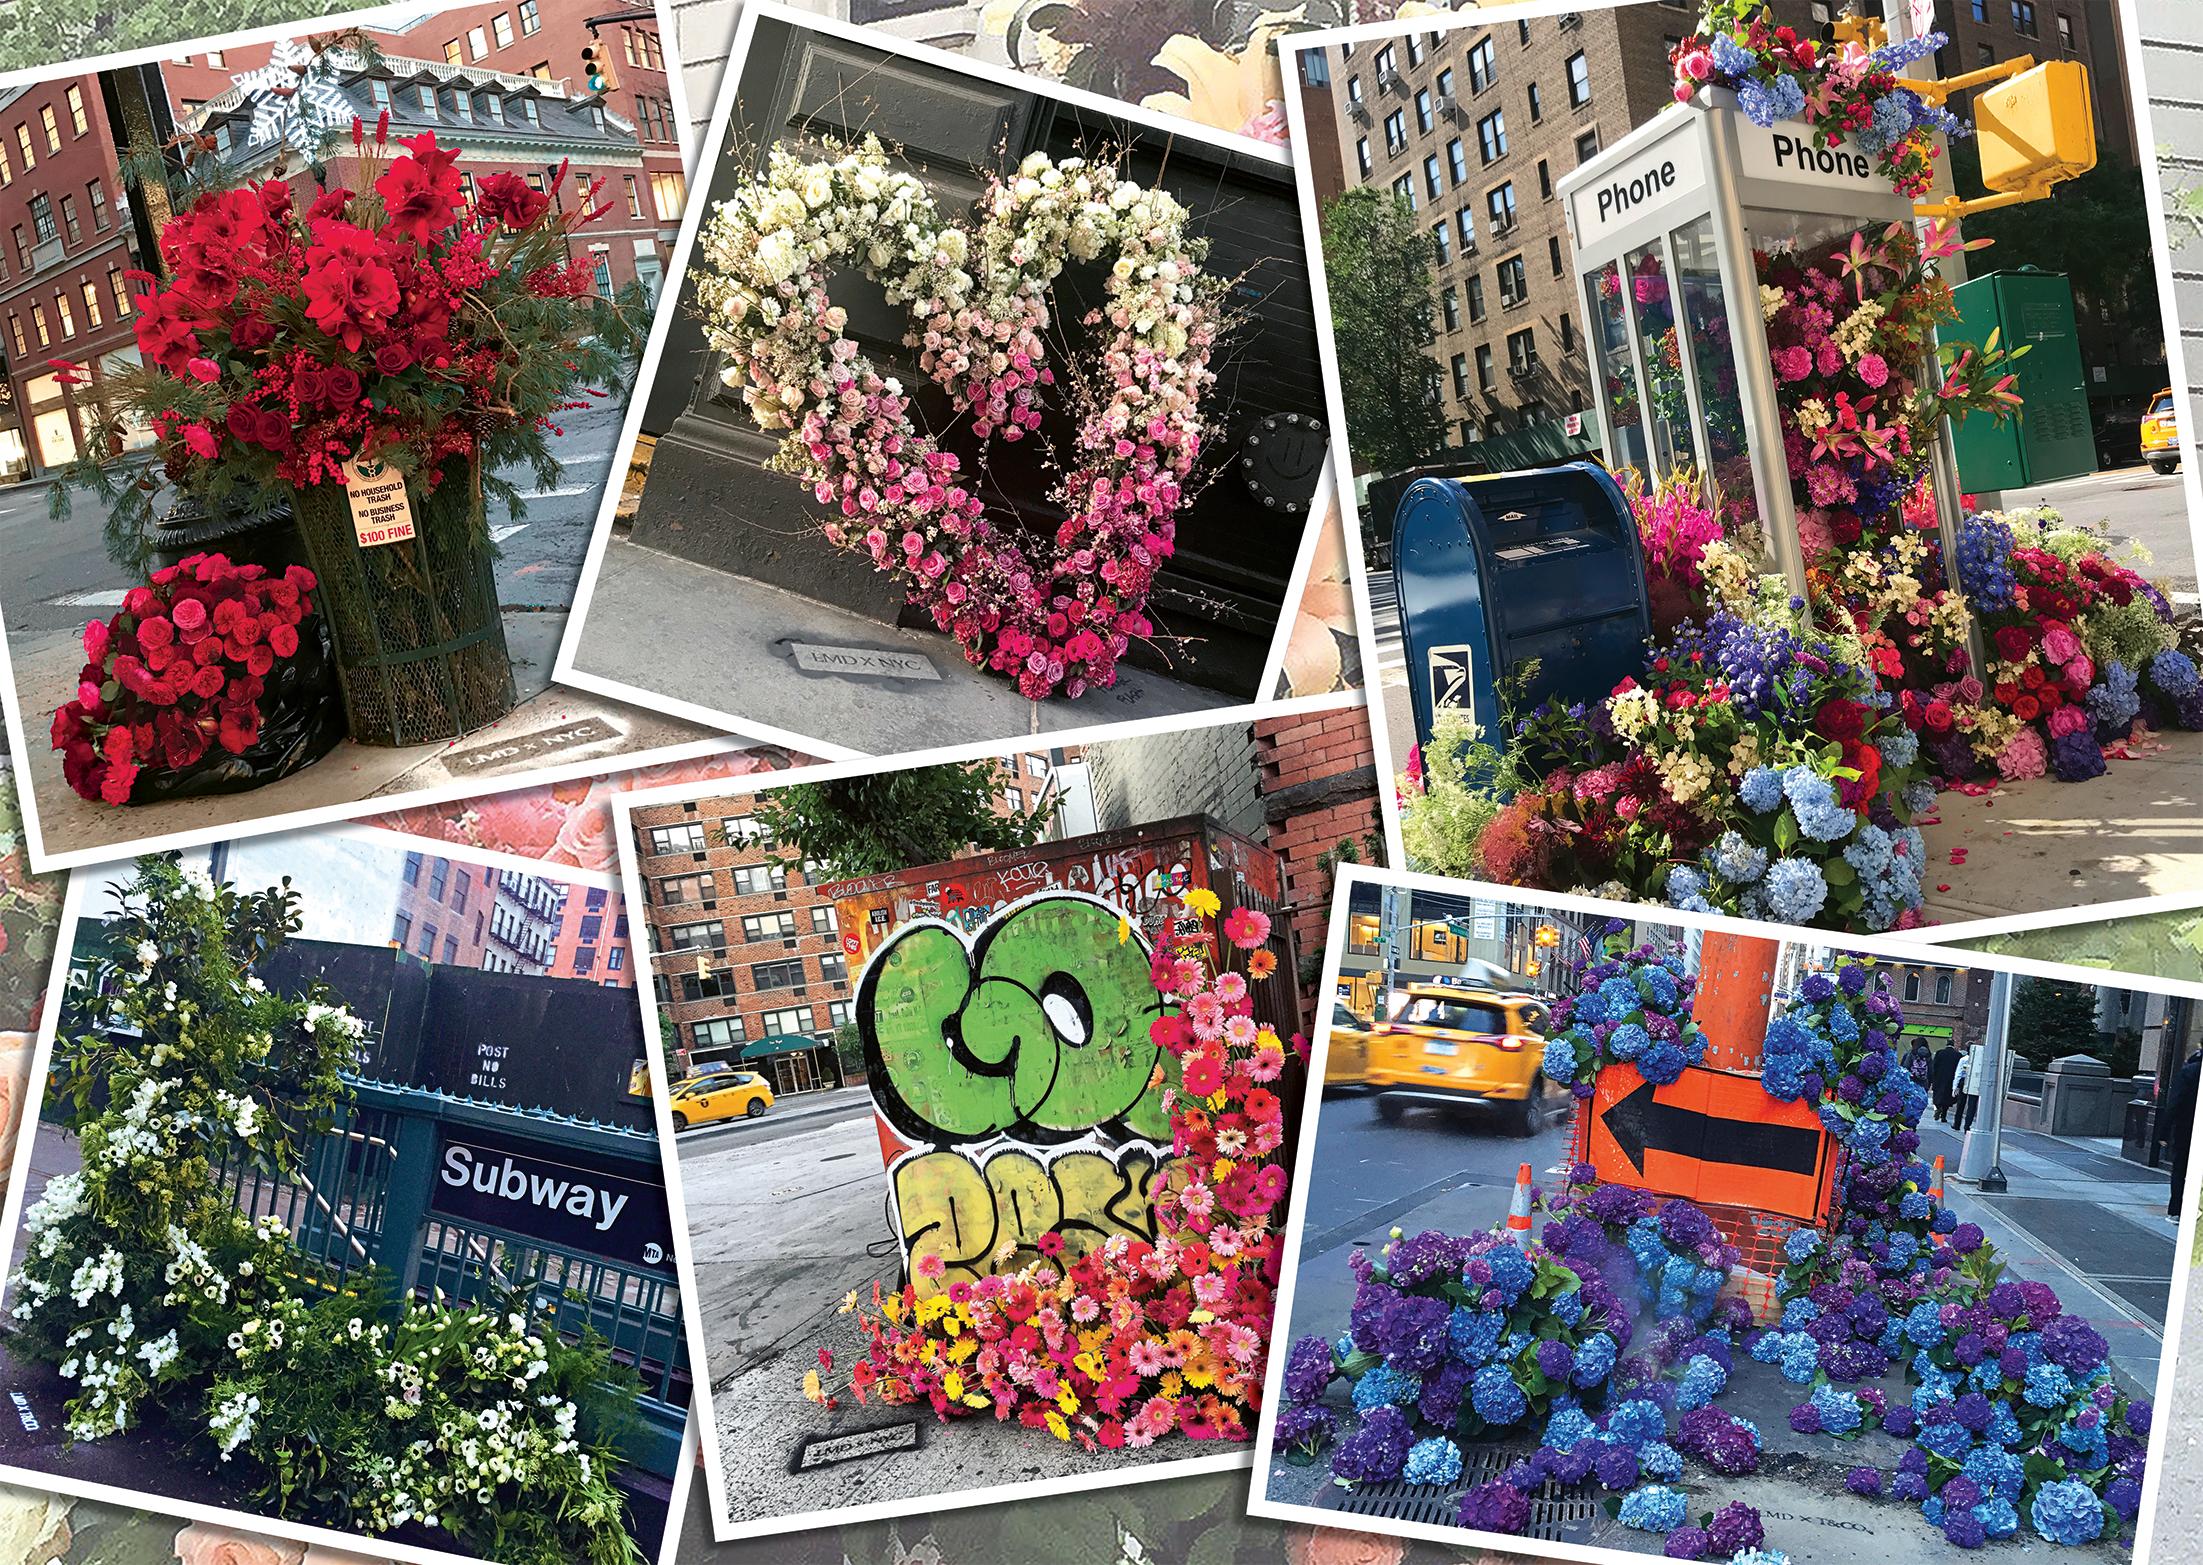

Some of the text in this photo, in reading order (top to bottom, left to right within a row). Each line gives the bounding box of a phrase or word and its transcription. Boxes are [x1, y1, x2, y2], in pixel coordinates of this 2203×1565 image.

[1772, 134, 1869, 178] Phone
[1597, 161, 1675, 222] Phone
[361, 482, 403, 496] HOUSEHOLD
[367, 493, 391, 504] TRASH
[358, 503, 405, 518] NO BUSINESS
[371, 513, 396, 524] TRASH
[360, 524, 413, 544] $100 FINE
[878, 657, 921, 671] NYC
[466, 746, 520, 766] LMD
[542, 726, 598, 746] NYC
[477, 1044, 509, 1059] POST
[482, 1060, 499, 1073] NO
[470, 1074, 507, 1089] BILLS
[441, 1146, 629, 1231] Subway
